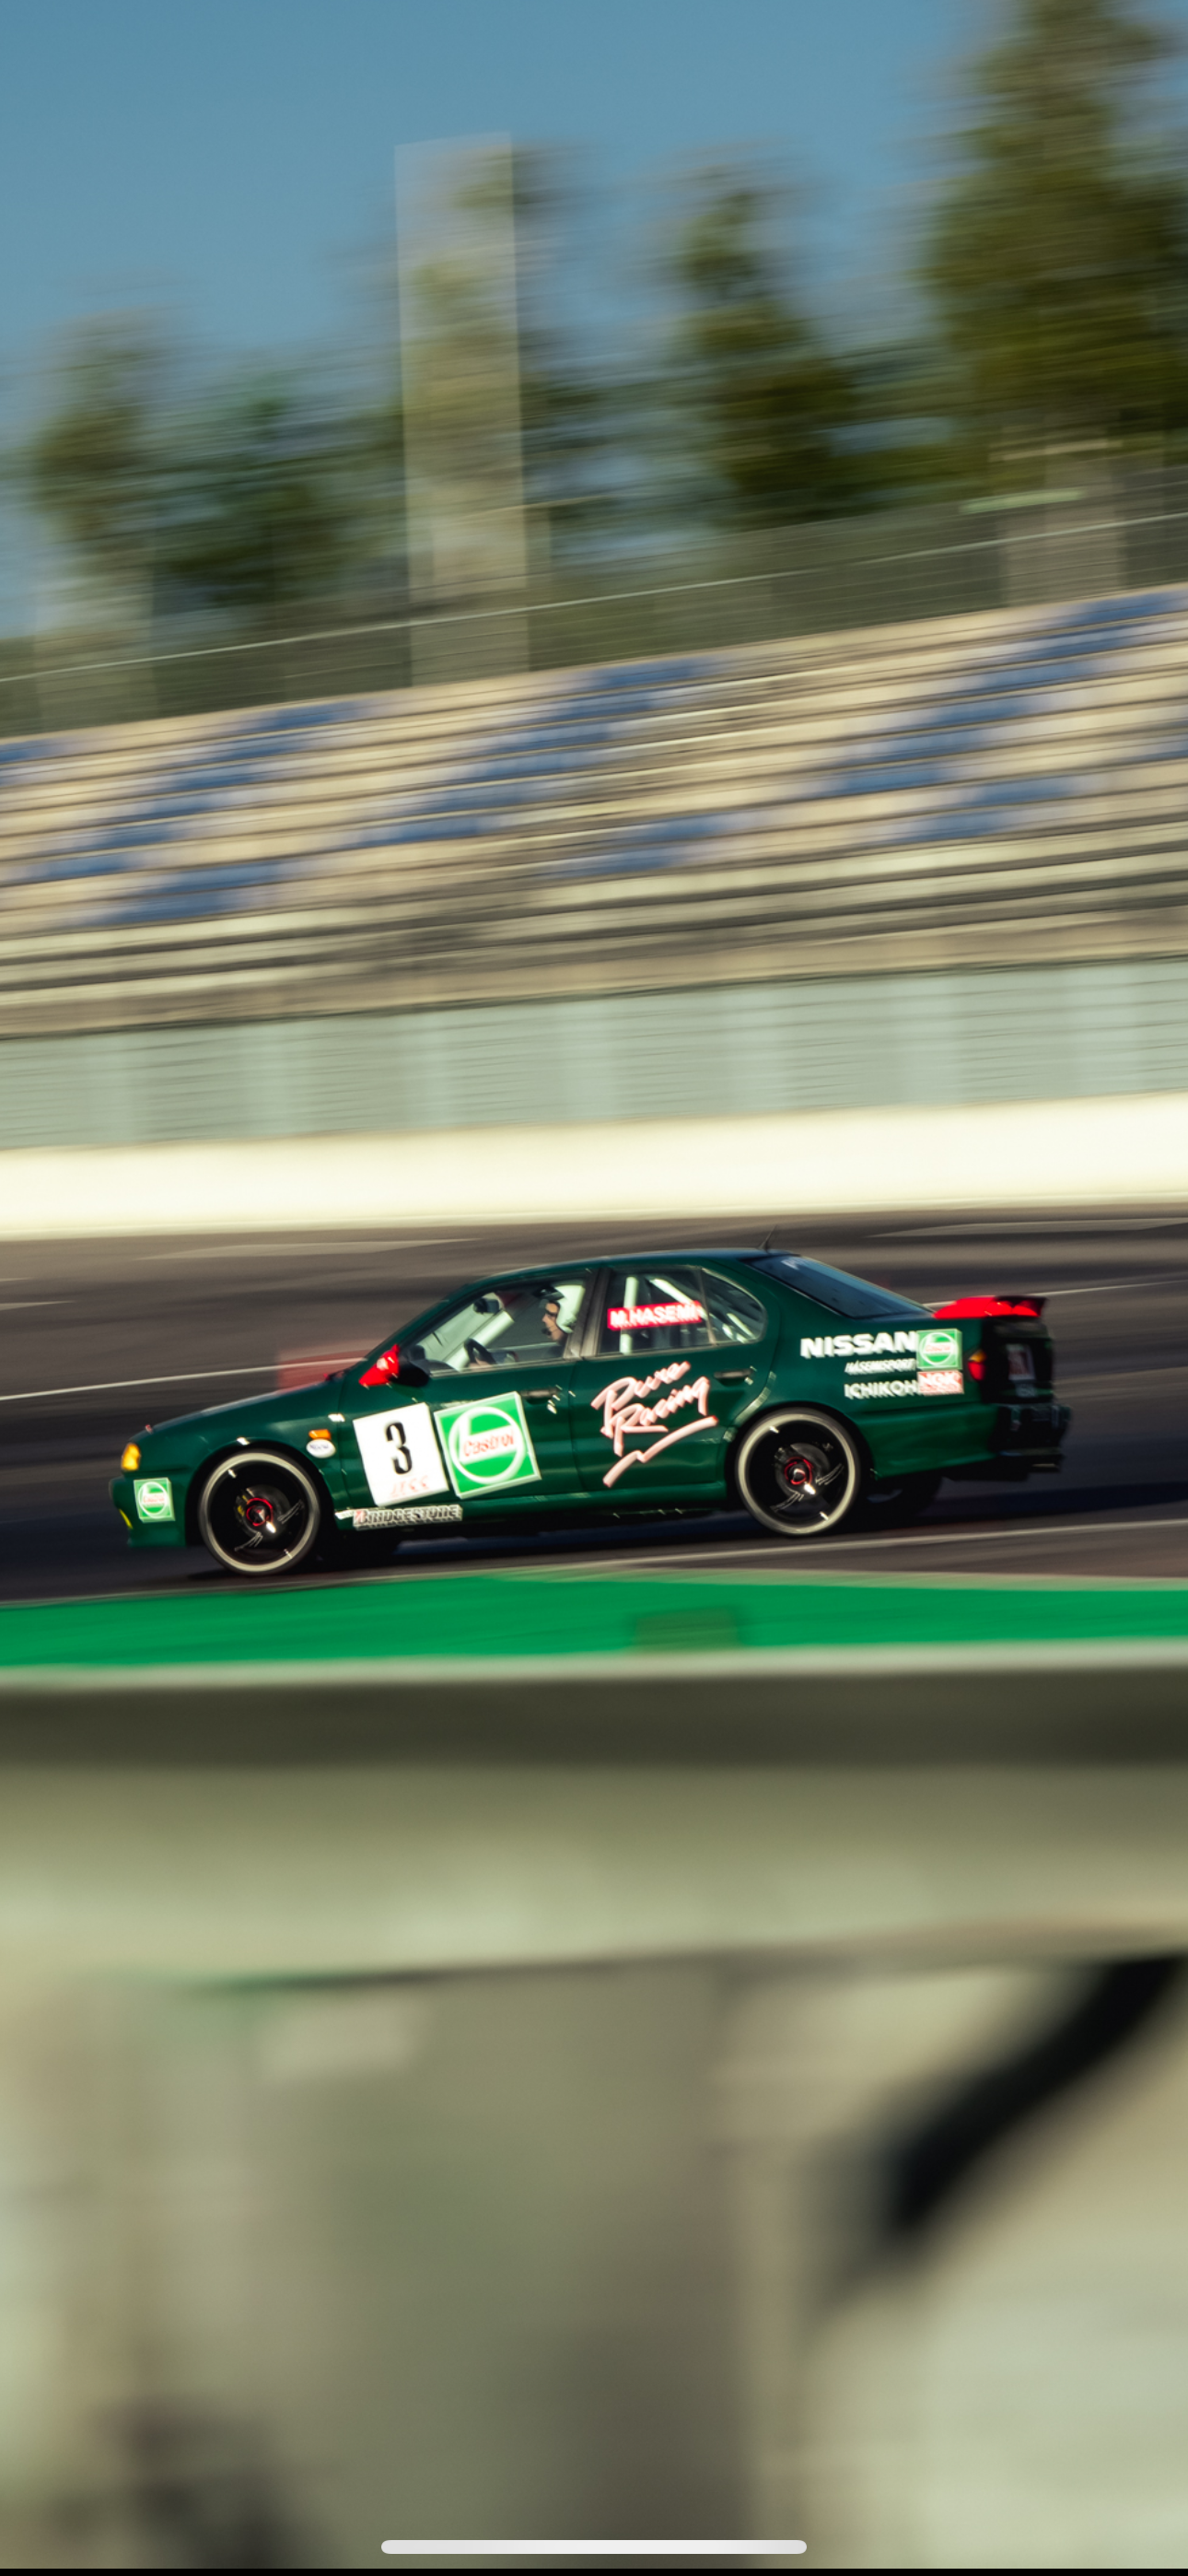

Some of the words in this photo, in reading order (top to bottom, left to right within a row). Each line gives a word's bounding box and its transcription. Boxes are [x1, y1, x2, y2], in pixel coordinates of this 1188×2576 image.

[800, 1331, 918, 1358] NISSAN
[590, 1361, 691, 1439] Pure
[601, 1376, 710, 1458] Racing
[385, 1421, 413, 1474] 3
[462, 1433, 515, 1458] Castrol
[354, 1505, 460, 1527] BRIDGESTONE
